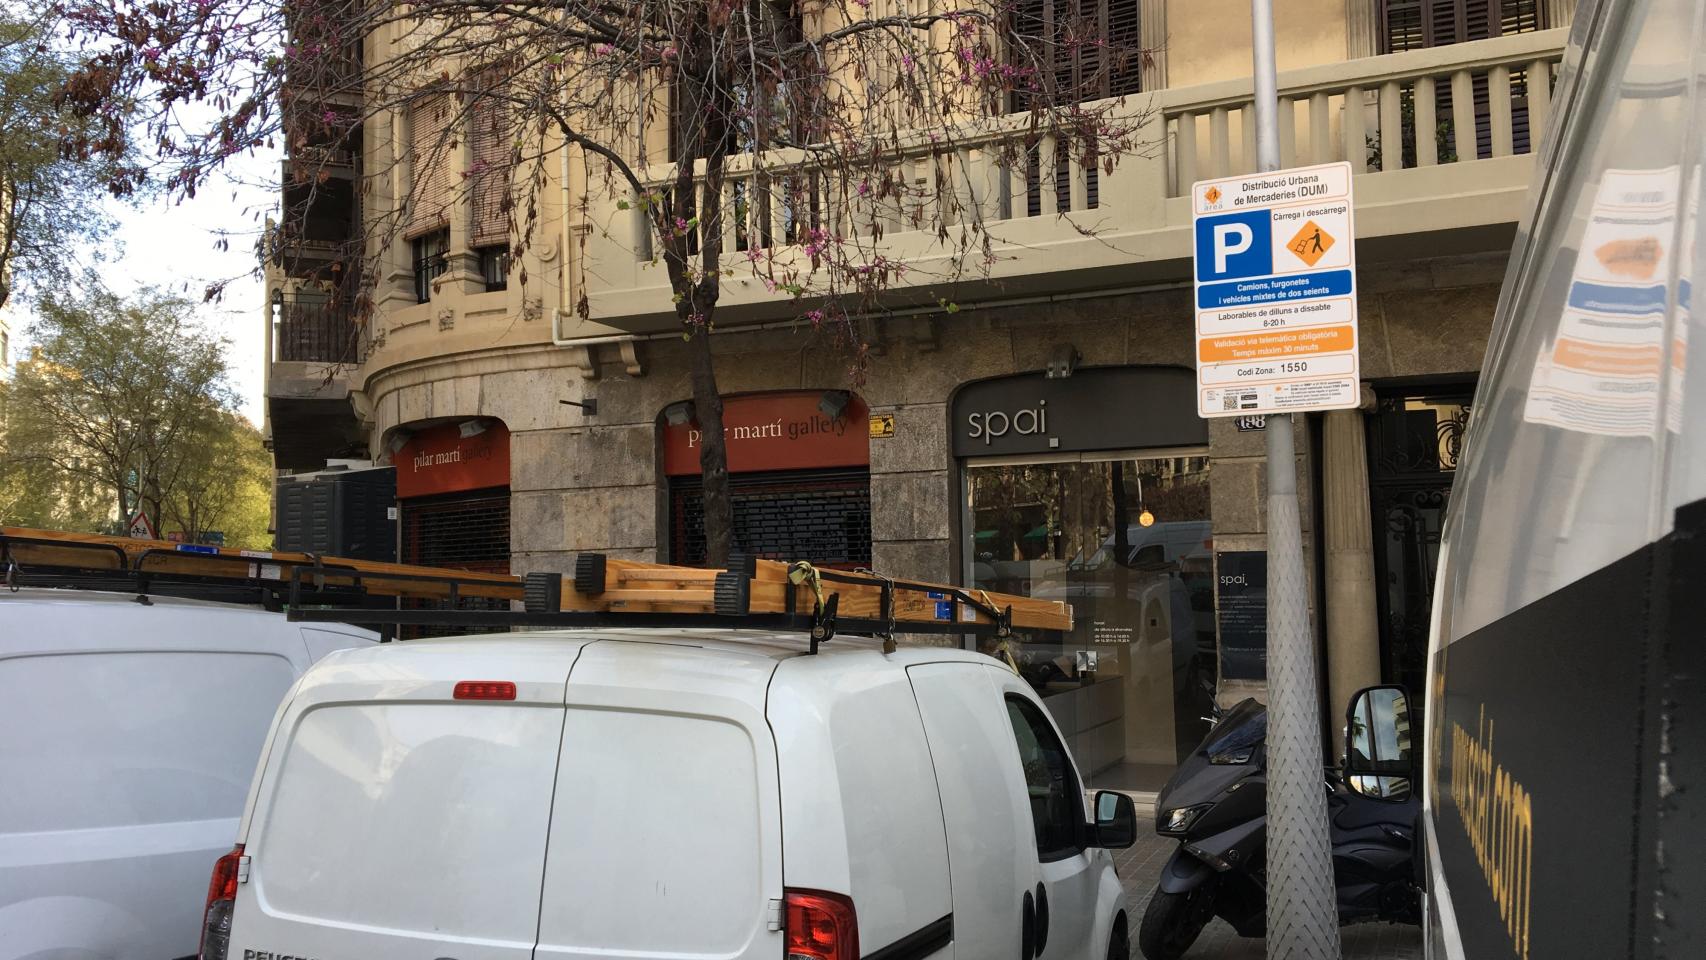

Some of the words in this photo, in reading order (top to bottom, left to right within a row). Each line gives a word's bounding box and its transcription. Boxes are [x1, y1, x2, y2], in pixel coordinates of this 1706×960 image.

[1242, 179, 1286, 191] Distribució
[1289, 175, 1319, 185] Urbana
[1234, 196, 1244, 206] de
[1246, 191, 1296, 204] Mercaderies
[1298, 184, 1328, 197] (DUM)
[1273, 211, 1301, 221] Càrrega
[1307, 206, 1347, 217] descàrrega
[1214, 223, 1253, 274] P
[1237, 282, 1270, 292] Camions,
[1271, 278, 1309, 289] furgonetes
[1222, 294, 1251, 305] vehicles
[1252, 292, 1276, 301] mixtes
[1277, 290, 1286, 299] de
[1288, 289, 1301, 298] dos
[1303, 286, 1330, 296] seients
[1218, 310, 1257, 321] Laborables
[1258, 309, 1267, 317] de
[1269, 306, 1292, 316] dilluns
[1300, 303, 1331, 313] dissabte
[1263, 319, 1279, 327] 8-20
[1214, 338, 1246, 348] Validació
[1247, 337, 1258, 346] via
[1259, 333, 1297, 344] telemàtica
[1298, 330, 1338, 341] obligatòria
[1232, 348, 1257, 358] Temps
[1257, 346, 1282, 355] màxim
[1293, 343, 1319, 352] minuts
[1237, 367, 1253, 377] Codi
[1255, 366, 1275, 376] Zona:
[1280, 361, 1307, 373] 1550
[733, 418, 782, 440] martí
[789, 415, 848, 440] gallery
[414, 450, 434, 473] pilar
[435, 445, 460, 465] martí
